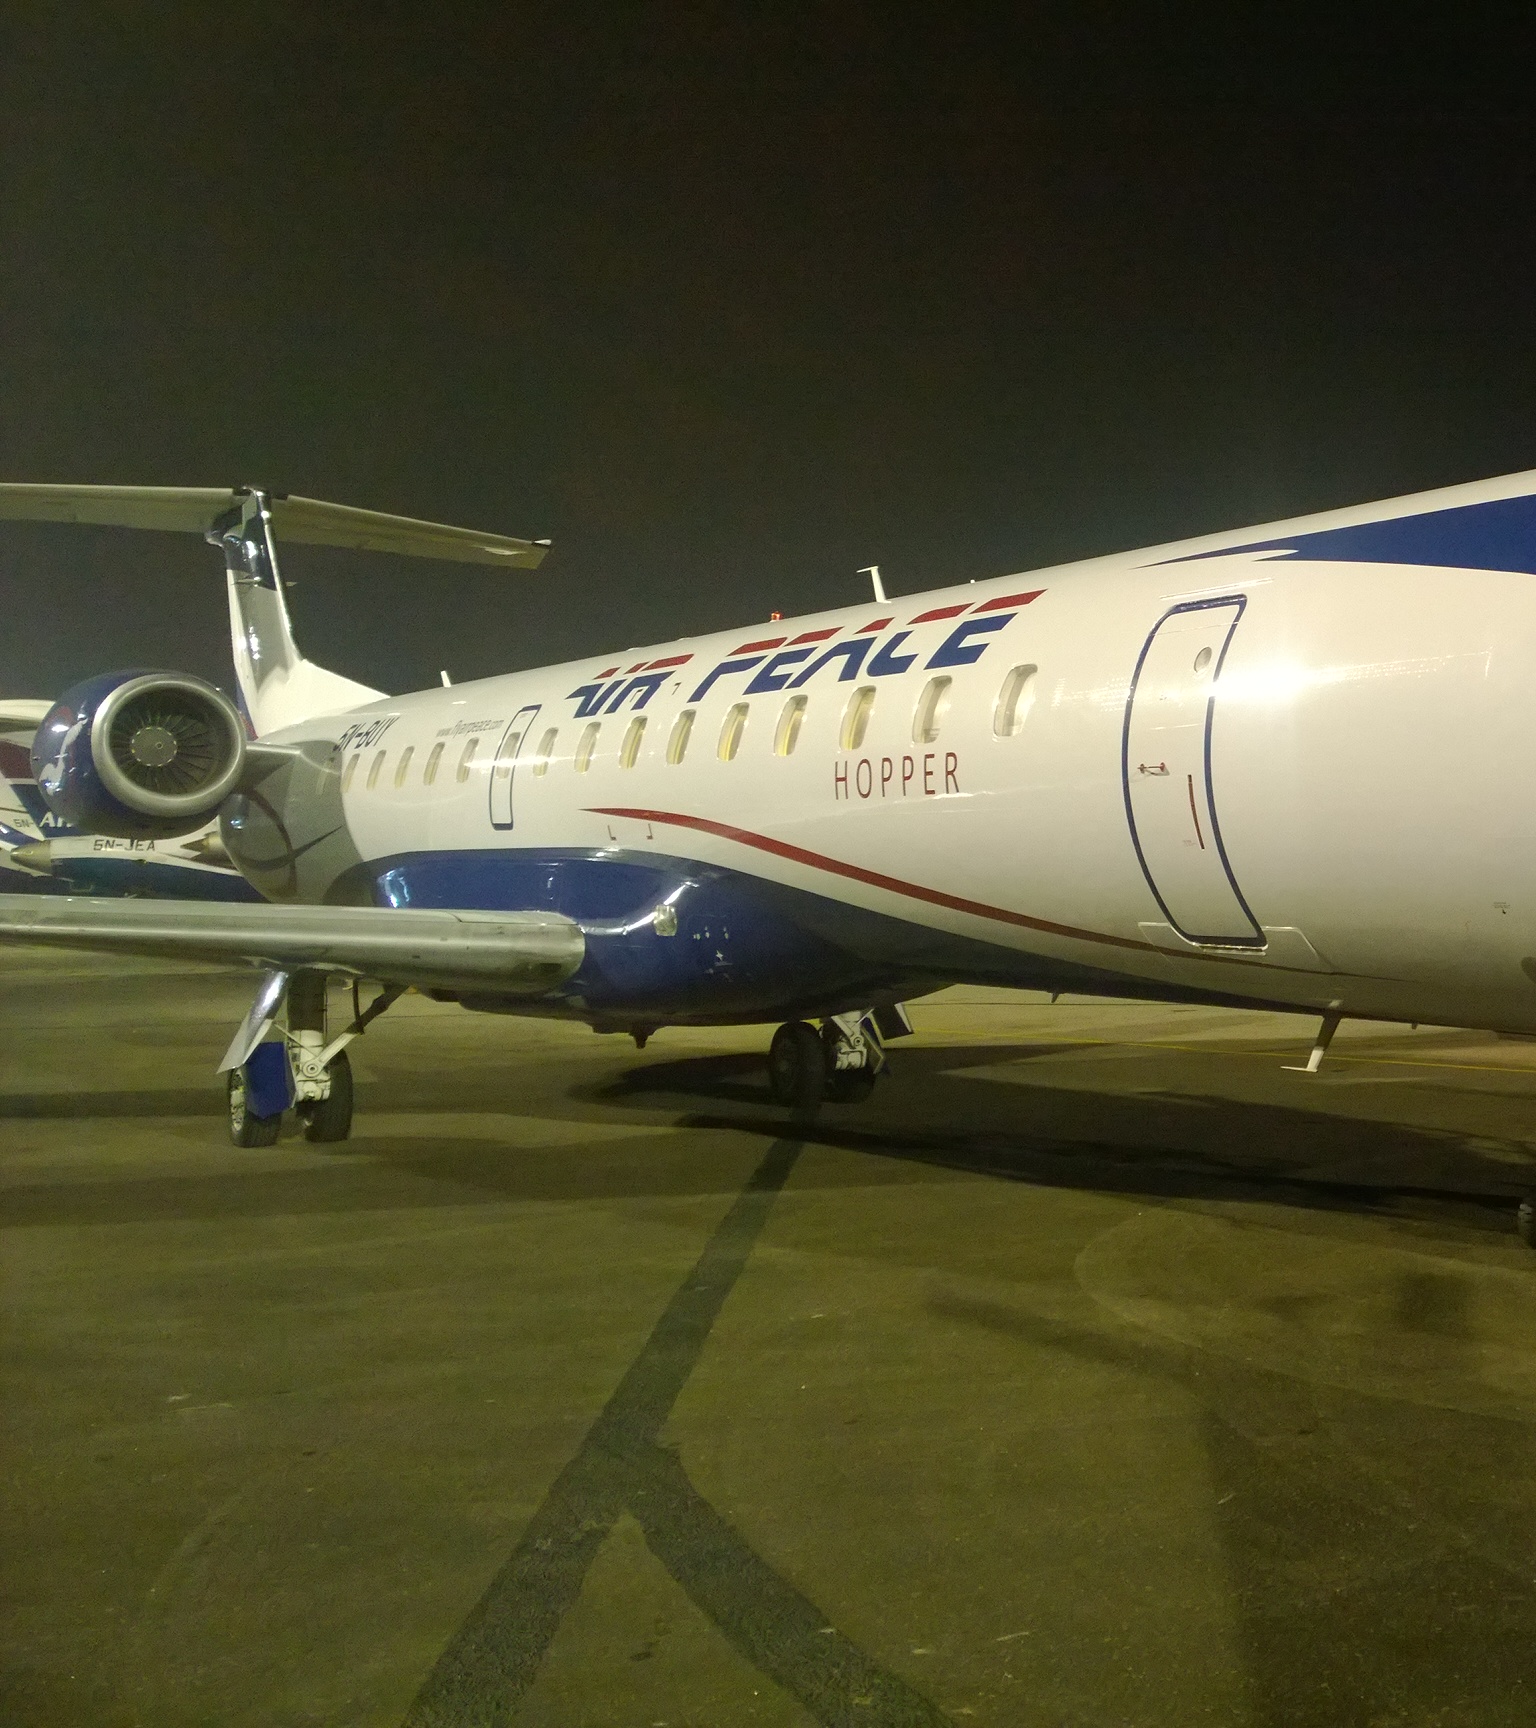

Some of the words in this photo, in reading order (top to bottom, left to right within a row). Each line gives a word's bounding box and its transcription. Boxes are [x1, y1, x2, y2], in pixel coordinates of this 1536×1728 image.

[566, 653, 695, 719] AIR
[686, 589, 1048, 704] PEACE
[334, 716, 400, 751] 5N-BUY
[834, 751, 960, 801] HOPPER
[93, 839, 156, 851] 5N-JEA
